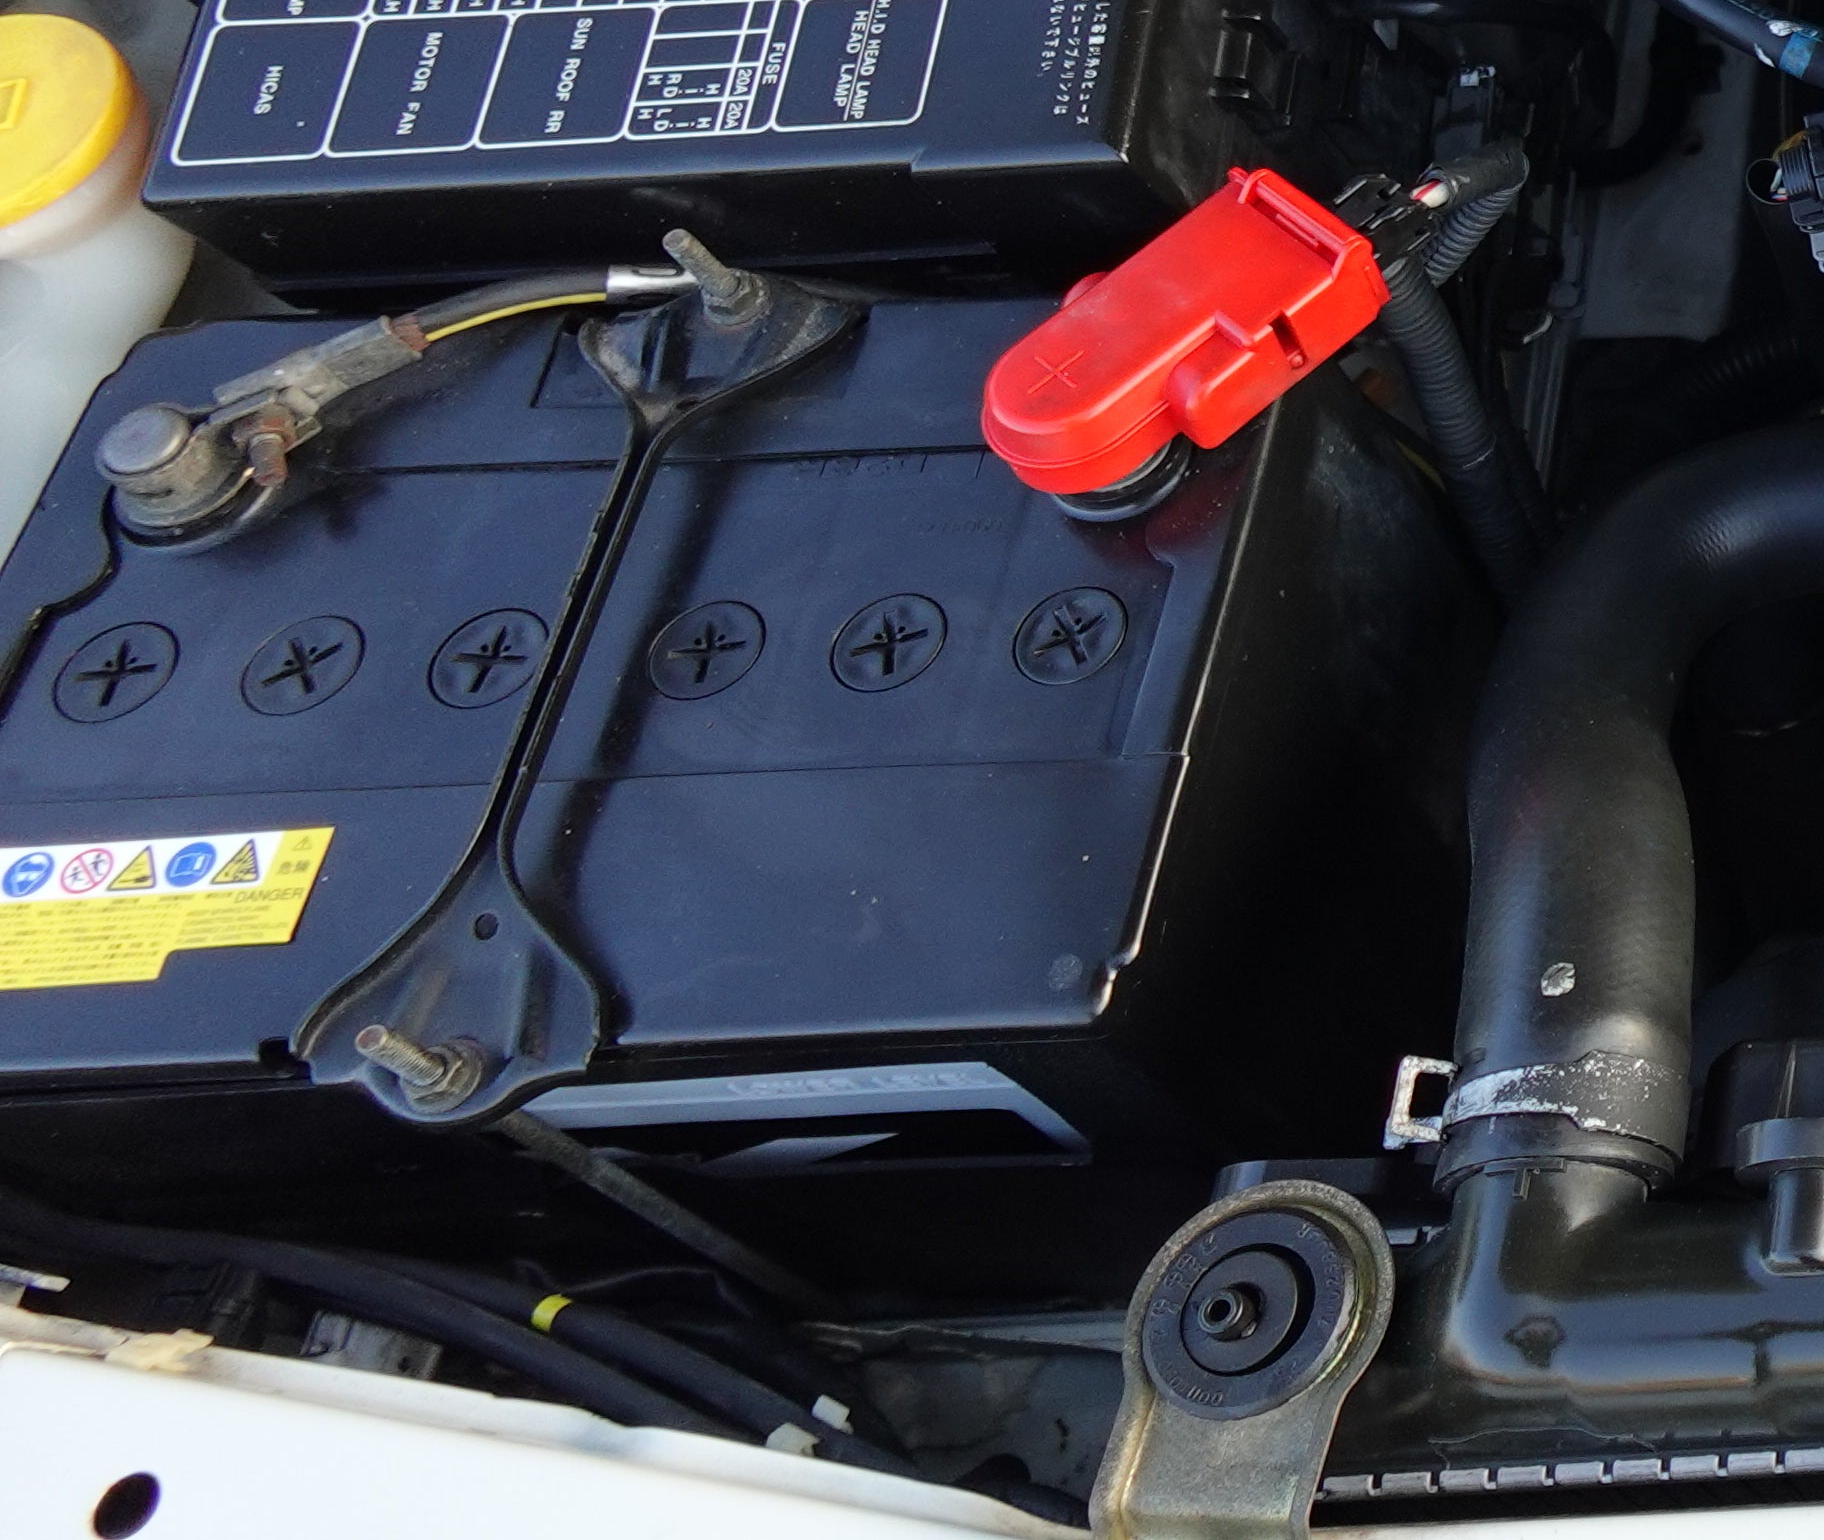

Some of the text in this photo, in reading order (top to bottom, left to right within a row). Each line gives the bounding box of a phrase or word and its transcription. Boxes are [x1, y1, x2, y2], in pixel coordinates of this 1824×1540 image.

[544, 17, 593, 134] SUN ROOF RR
[762, 41, 786, 86] FUSE
[833, 10, 870, 107] HEAD LAMP
[860, 39, 882, 76] HEAD
[253, 65, 284, 115] HICAS
[396, 32, 443, 136] MOTOR FAN
[733, 68, 753, 96] 20A
[850, 81, 871, 120] LAMP
[724, 102, 744, 130] 20A
[234, 887, 304, 904] DANGER
